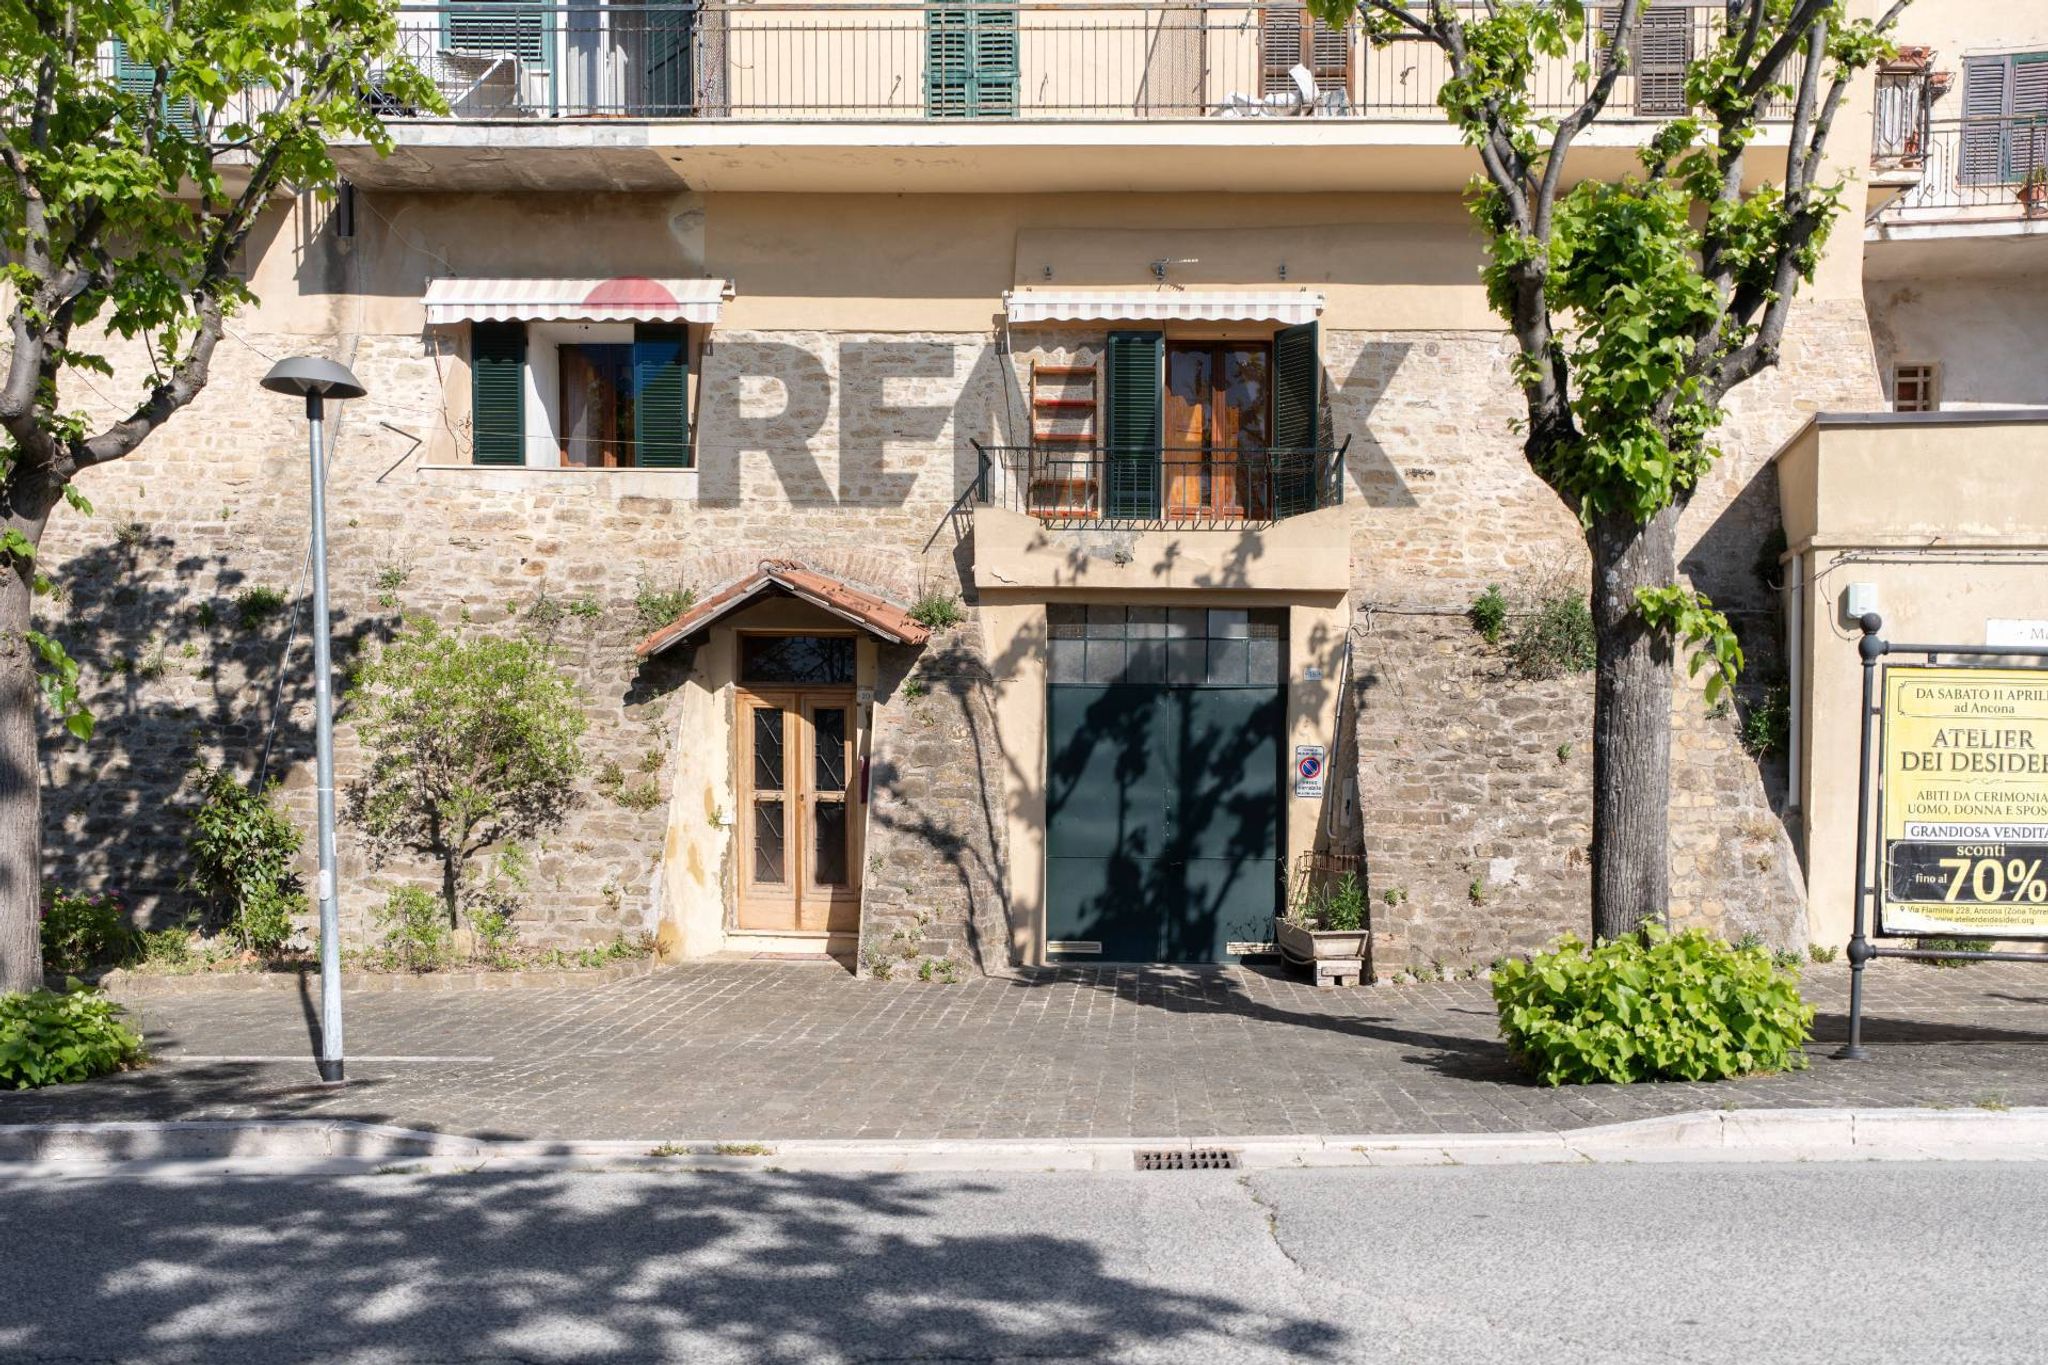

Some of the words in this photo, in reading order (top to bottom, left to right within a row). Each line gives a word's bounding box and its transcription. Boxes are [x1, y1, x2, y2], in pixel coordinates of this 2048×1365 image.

[2030, 627, 2048, 640] M
[1916, 688, 1934, 699] DA
[1937, 688, 1990, 700] SABATO
[1993, 689, 2003, 700] 11
[2006, 689, 2048, 701] APRIL
[1954, 702, 1968, 713] ad
[1971, 703, 2015, 714] Ancona
[1932, 728, 2036, 750] ATELIER
[1901, 751, 1943, 772] DEI
[1916, 791, 1949, 801] ABITI
[1953, 791, 1971, 801] DA
[1974, 792, 2048, 803] CERIMONIA
[1907, 804, 1951, 815] UOMO,
[1954, 805, 2002, 815] DONNA
[2006, 806, 2013, 815] E
[1911, 826, 1990, 838] GRANDIOSA
[1956, 843, 2006, 857] sconti
[1915, 873, 1936, 884] fino
[1938, 874, 1948, 884] al
[1939, 858, 2047, 902] 70%
[1908, 905, 1920, 913] Via
[1921, 906, 1954, 914] Flaminia
